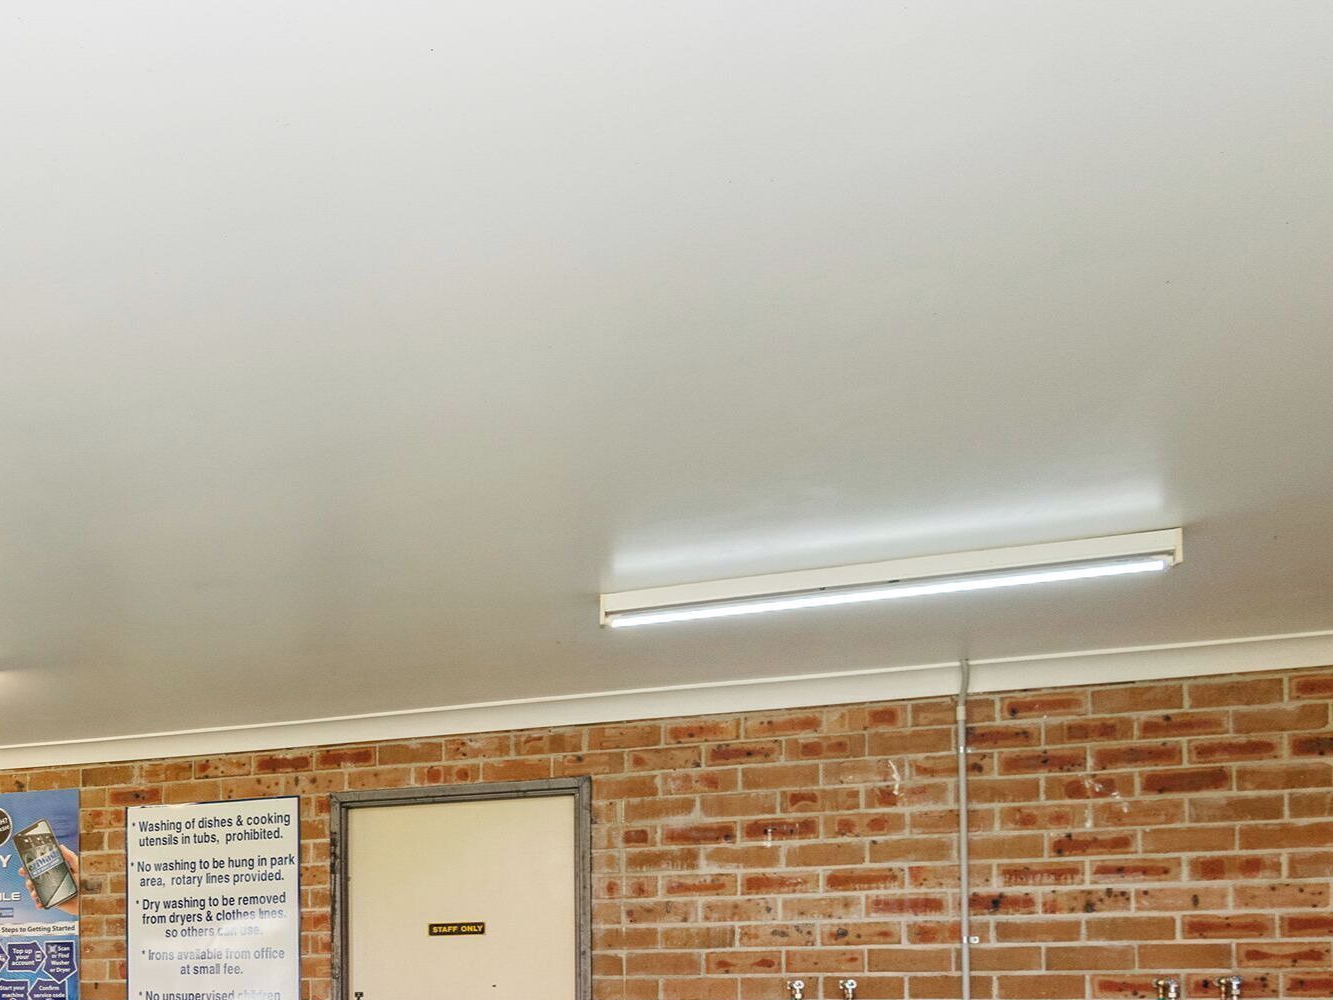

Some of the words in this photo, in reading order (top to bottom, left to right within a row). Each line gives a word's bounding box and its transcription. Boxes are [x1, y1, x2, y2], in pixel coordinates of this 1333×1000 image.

[138, 819, 182, 833] Washing
[185, 818, 195, 830] of
[198, 816, 233, 829] dishes
[235, 815, 244, 826] &
[246, 812, 291, 826] cooking
[139, 834, 179, 847] utensils
[181, 833, 191, 845] in
[193, 831, 220, 845] tubs,
[225, 828, 284, 844] prohibited.
[137, 861, 152, 873] No
[153, 859, 197, 874] washing
[199, 858, 210, 870] to
[212, 857, 225, 869] be
[227, 856, 255, 870] hung
[257, 855, 267, 867] in
[270, 853, 295, 867] park
[139, 877, 166, 888] area,
[171, 875, 203, 888] rotary
[205, 872, 230, 884] lines
[232, 869, 285, 886] provided.
[142, 898, 161, 913] Dry
[163, 896, 206, 910] washing
[208, 896, 219, 907] to
[221, 895, 235, 906] be
[238, 892, 286, 906] removed
[142, 913, 167, 925] from
[168, 911, 203, 926] dryers
[205, 910, 213, 922] &
[216, 908, 256, 921] clothes
[1, 926, 19, 934] Steps
[27, 925, 51, 933] Getting
[51, 924, 75, 932] Started
[165, 928, 178, 938] so
[180, 926, 215, 938] others
[148, 949, 174, 961] Irons
[177, 948, 223, 960] available
[224, 947, 251, 960] from
[253, 947, 285, 960] office
[180, 964, 190, 975] at
[193, 963, 221, 975] small
[223, 963, 244, 975] fee.
[237, 989, 281, 1000] chren
